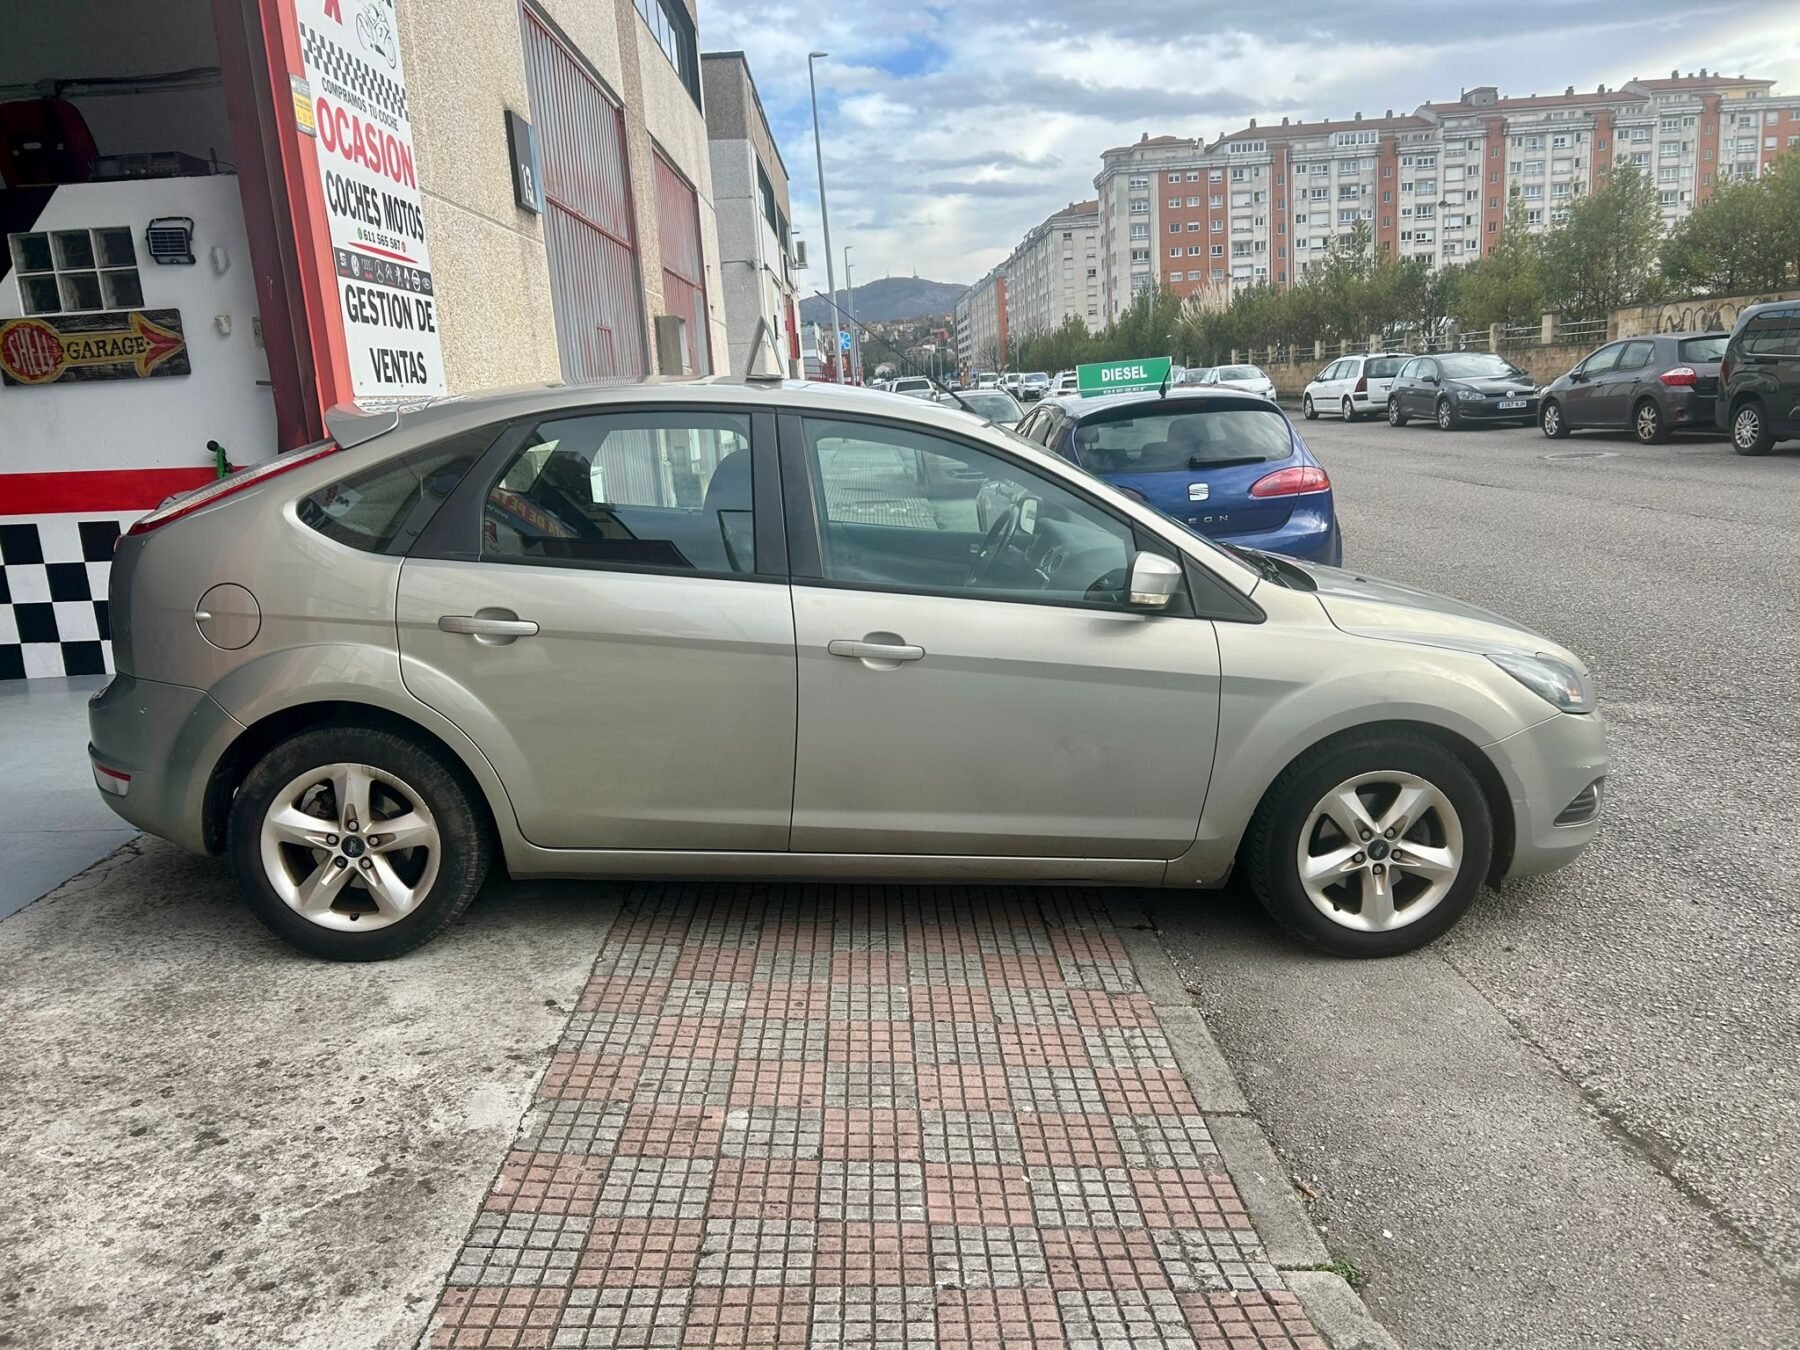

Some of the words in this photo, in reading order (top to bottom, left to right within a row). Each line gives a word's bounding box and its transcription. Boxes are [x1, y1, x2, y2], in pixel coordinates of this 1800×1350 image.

[321, 77, 367, 113] COMPRAMOS
[368, 104, 378, 119] TU
[378, 109, 399, 131] COCHE
[316, 96, 416, 190] OCASION
[325, 169, 382, 229] COCHES
[382, 191, 424, 243] MOTOS
[363, 229, 376, 243] 611
[345, 284, 414, 330] GESTION
[416, 298, 436, 333] DE
[8, 327, 52, 375] SHELL
[66, 336, 146, 360] GARAGE
[369, 347, 427, 385] VENTAS
[1101, 365, 1148, 382] DIESEL
[1188, 515, 1229, 524] EON
